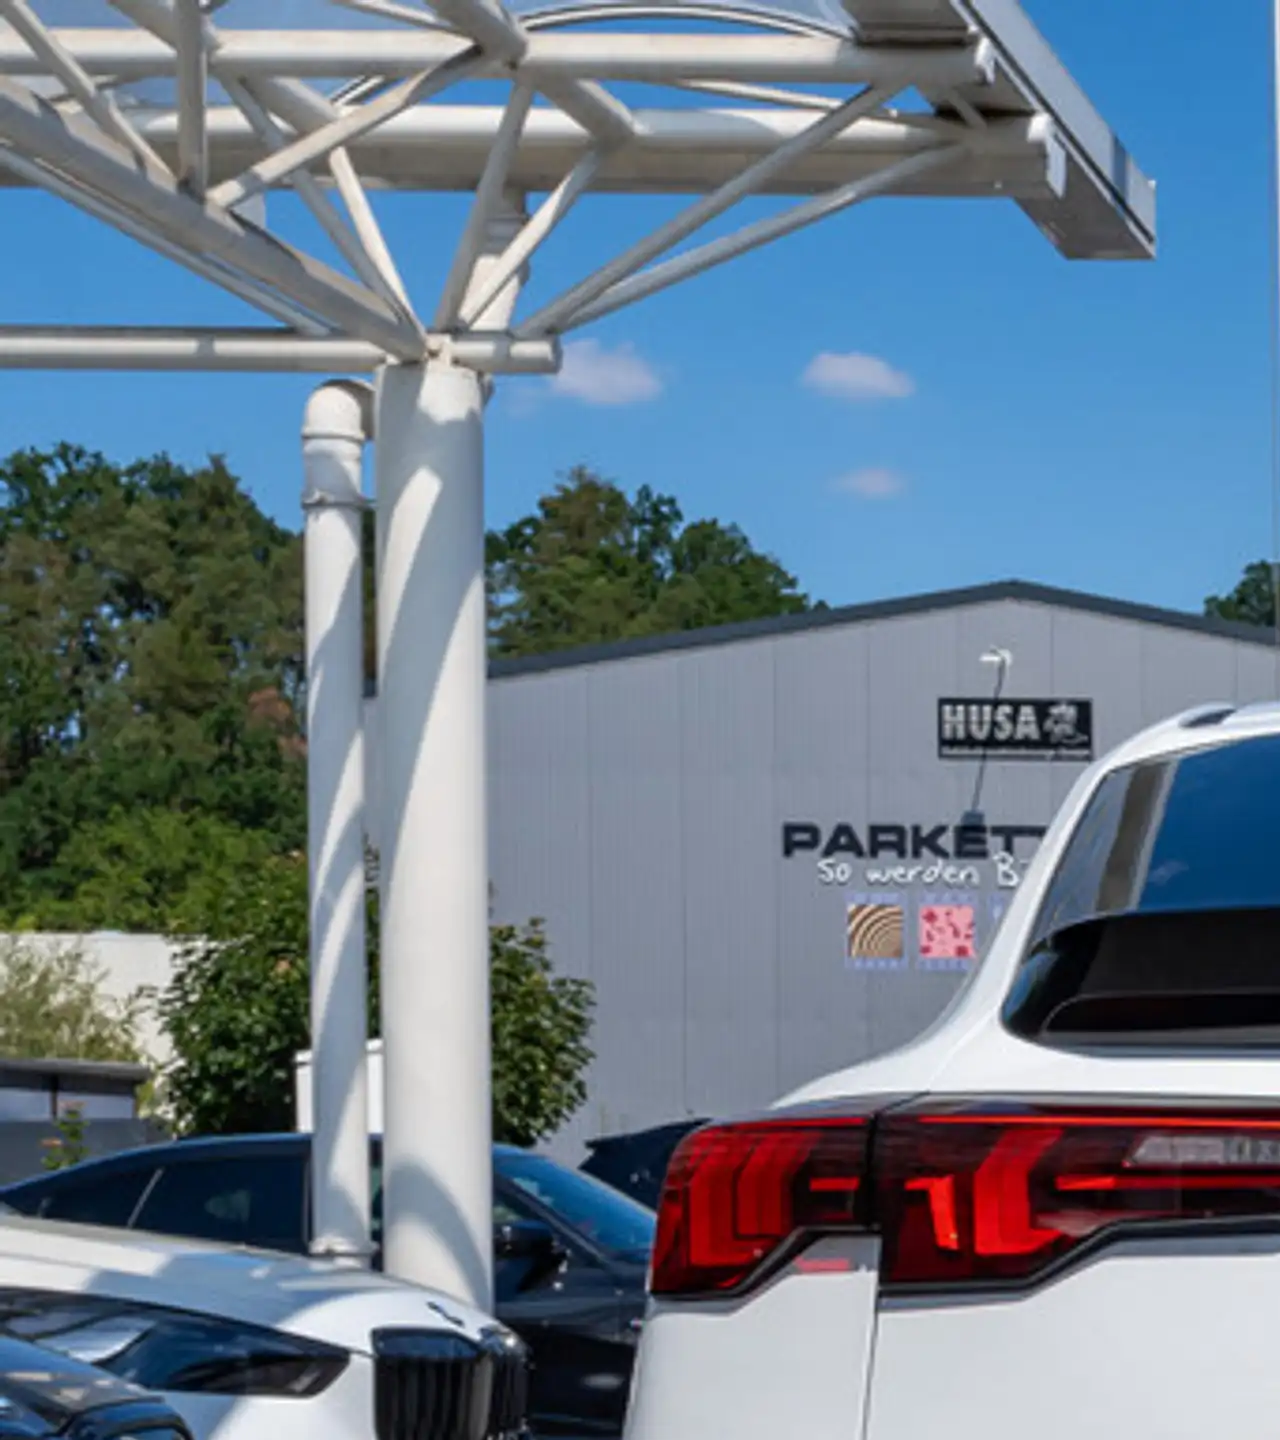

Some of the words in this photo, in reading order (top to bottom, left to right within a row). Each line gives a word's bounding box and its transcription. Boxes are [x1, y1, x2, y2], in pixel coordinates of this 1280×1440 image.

[941, 704, 1041, 741] HUSA
[816, 858, 852, 884] So
[866, 857, 980, 884] werden
